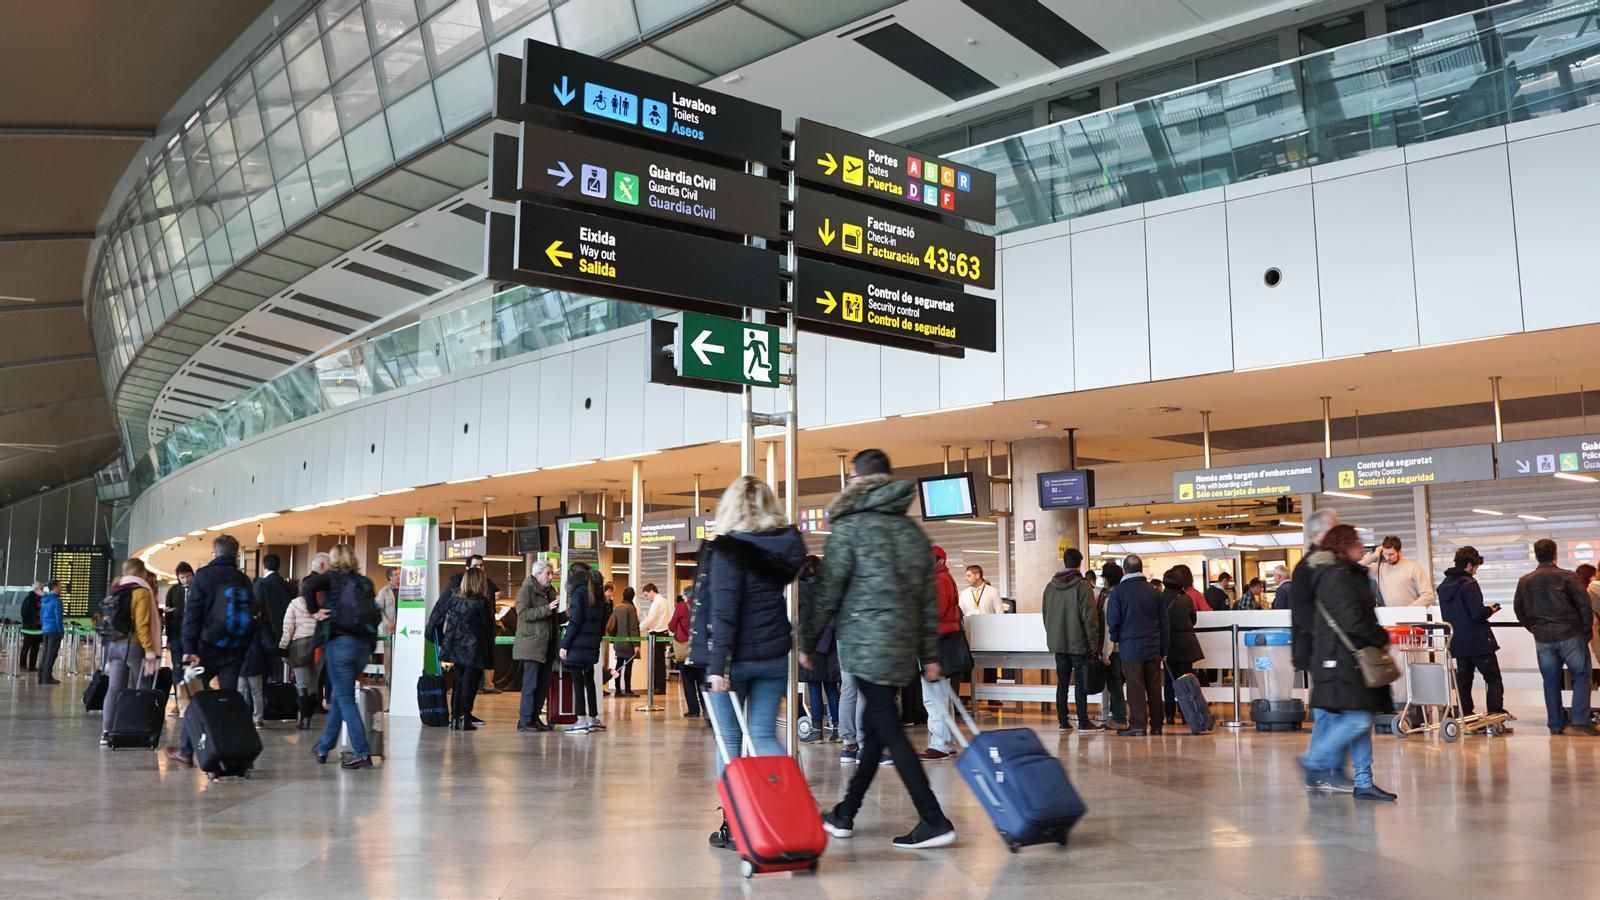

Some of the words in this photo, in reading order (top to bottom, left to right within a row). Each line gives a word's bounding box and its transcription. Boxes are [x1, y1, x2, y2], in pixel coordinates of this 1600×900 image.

[672, 91, 717, 116] Lavabos
[673, 107, 699, 124] Toilets
[671, 121, 705, 140] Aseos
[649, 164, 692, 186] Guàrdia
[693, 174, 716, 191] Civil
[868, 149, 898, 168] Portes
[910, 161, 918, 175] A
[927, 166, 935, 179] B
[944, 170, 951, 183] C
[960, 175, 968, 188] R
[868, 164, 889, 178] Gates
[648, 180, 680, 198] Guardia
[681, 186, 698, 201] Civil
[867, 175, 903, 196] Puertas
[910, 183, 918, 197] D
[927, 189, 934, 202] E
[944, 193, 951, 206] F
[648, 194, 692, 215] Guardia
[693, 204, 716, 220] Civil
[579, 226, 616, 247] Eixida
[867, 216, 915, 239] Facturació
[867, 230, 897, 247] Check-in
[579, 243, 599, 260] Way
[600, 249, 616, 262] out
[866, 243, 920, 266] Facturación
[923, 245, 949, 273] 43
[949, 250, 957, 262] to
[956, 252, 981, 280] 63
[578, 258, 616, 278] Salida
[949, 265, 956, 275] a
[867, 283, 900, 301] Control
[901, 291, 913, 304] de
[914, 295, 955, 313] seguretat
[868, 299, 896, 315] Security
[897, 305, 920, 318] control
[867, 311, 900, 329] Control
[901, 318, 913, 330] de
[914, 322, 956, 339] seguridad
[1357, 459, 1384, 470] Control
[1385, 458, 1395, 468] de
[1395, 456, 1433, 467] seguretat
[1357, 470, 1381, 478] Security
[1358, 477, 1385, 487] Control
[1386, 475, 1396, 484] de
[1397, 472, 1435, 485] seguridad
[1247, 487, 1256, 495] de
